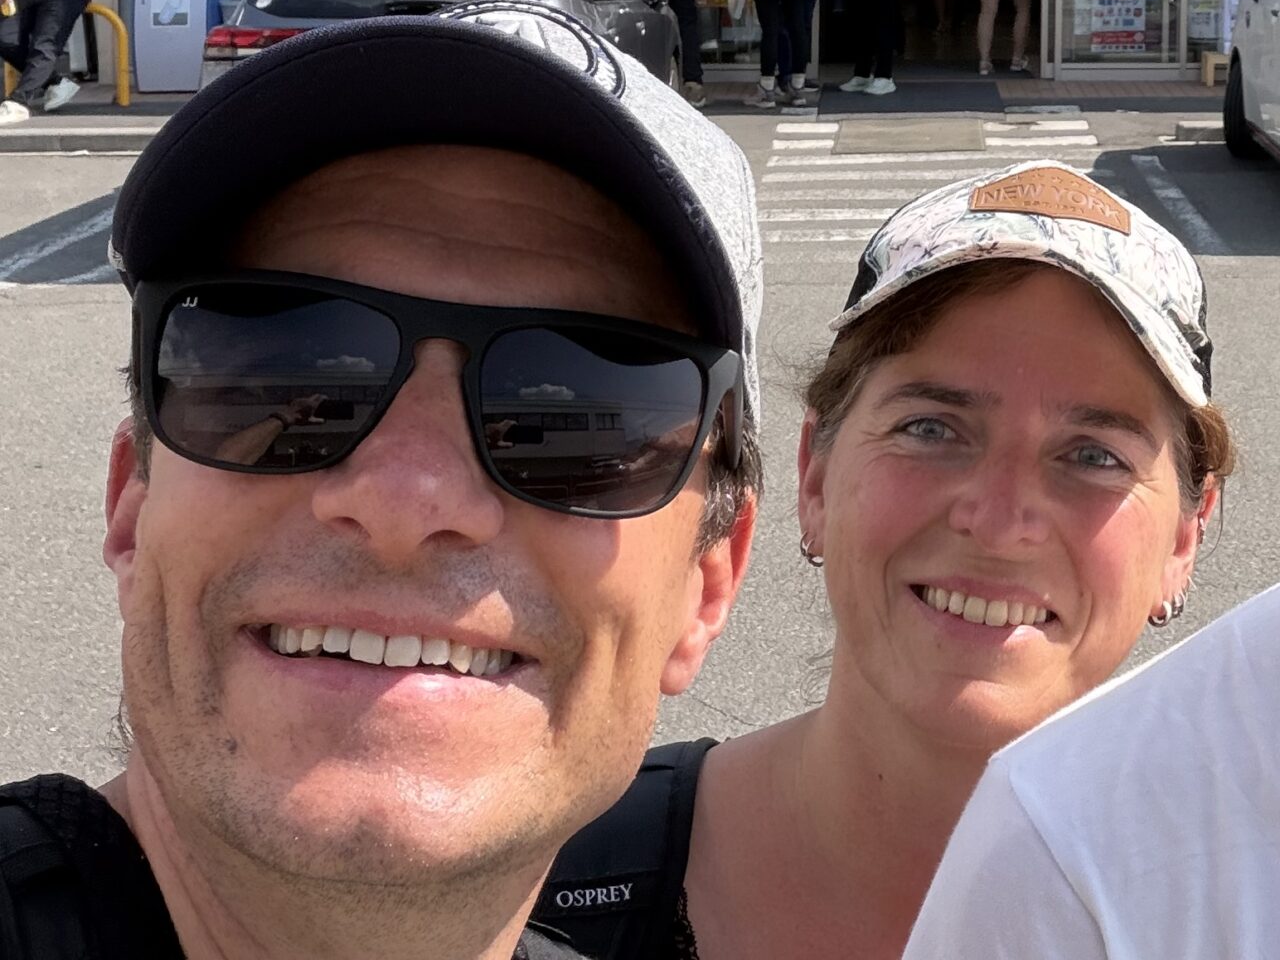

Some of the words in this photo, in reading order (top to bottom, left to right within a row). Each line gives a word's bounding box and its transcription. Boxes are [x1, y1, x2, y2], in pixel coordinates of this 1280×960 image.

[982, 183, 1044, 204] NEW
[1054, 186, 1123, 224] YORK
[556, 882, 633, 908] OSPREY
